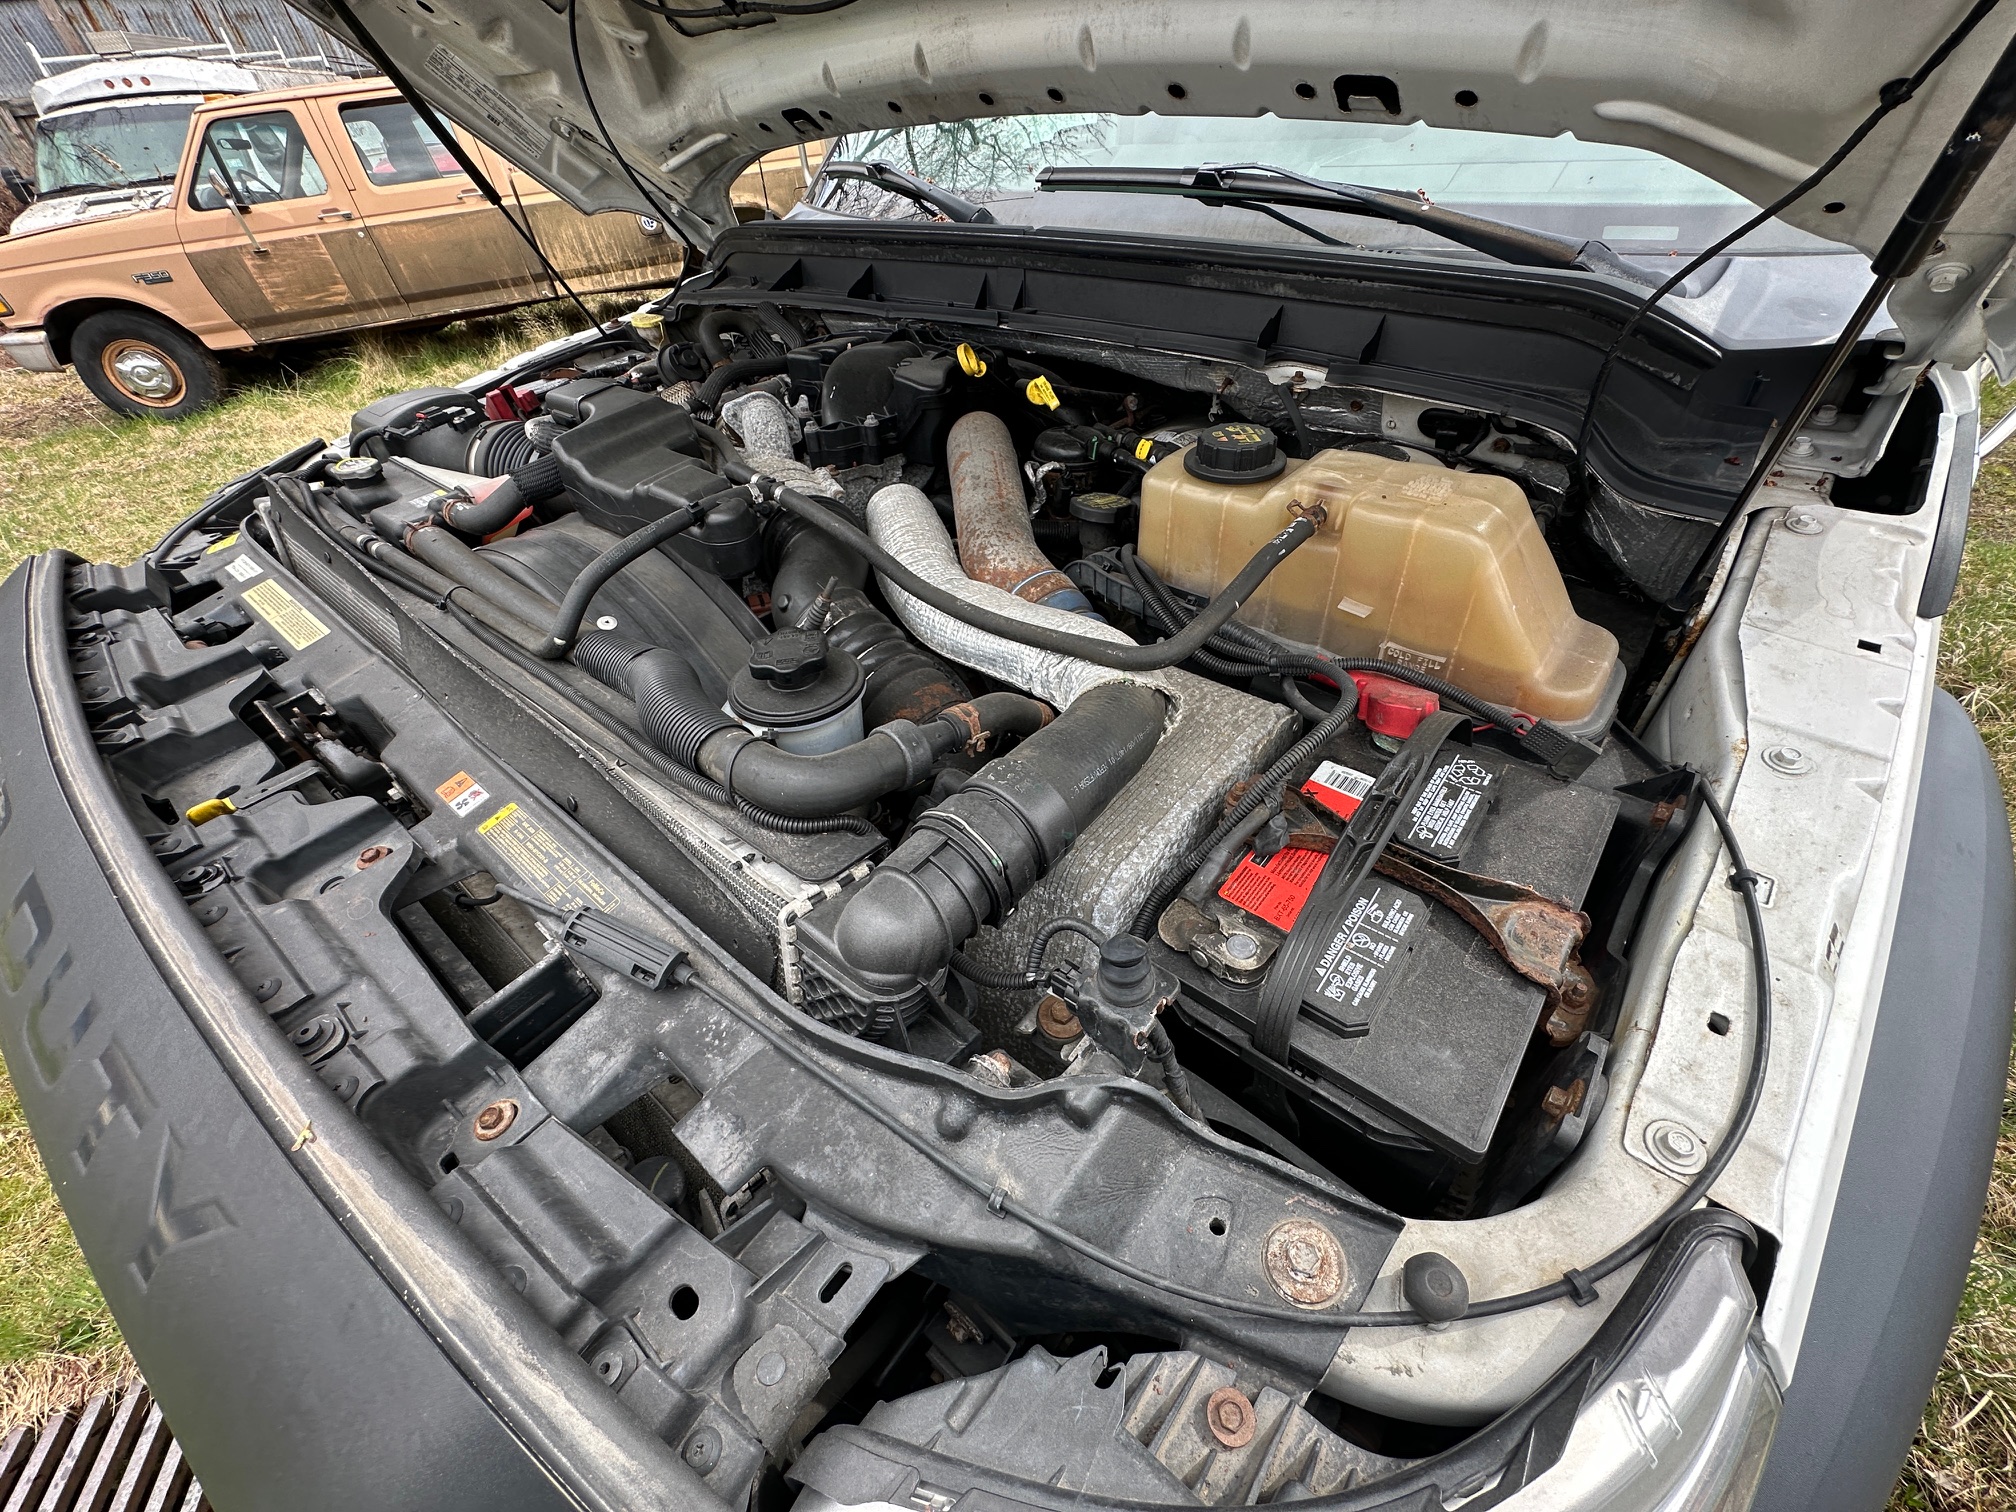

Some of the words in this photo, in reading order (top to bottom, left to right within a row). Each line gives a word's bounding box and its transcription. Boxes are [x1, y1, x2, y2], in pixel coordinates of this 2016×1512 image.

[131, 270, 170, 284] F350
[1387, 647, 1411, 661] COLD
[1416, 657, 1441, 670] FILL
[1320, 932, 1348, 968] DANGER
[1345, 897, 1369, 927] POISON
